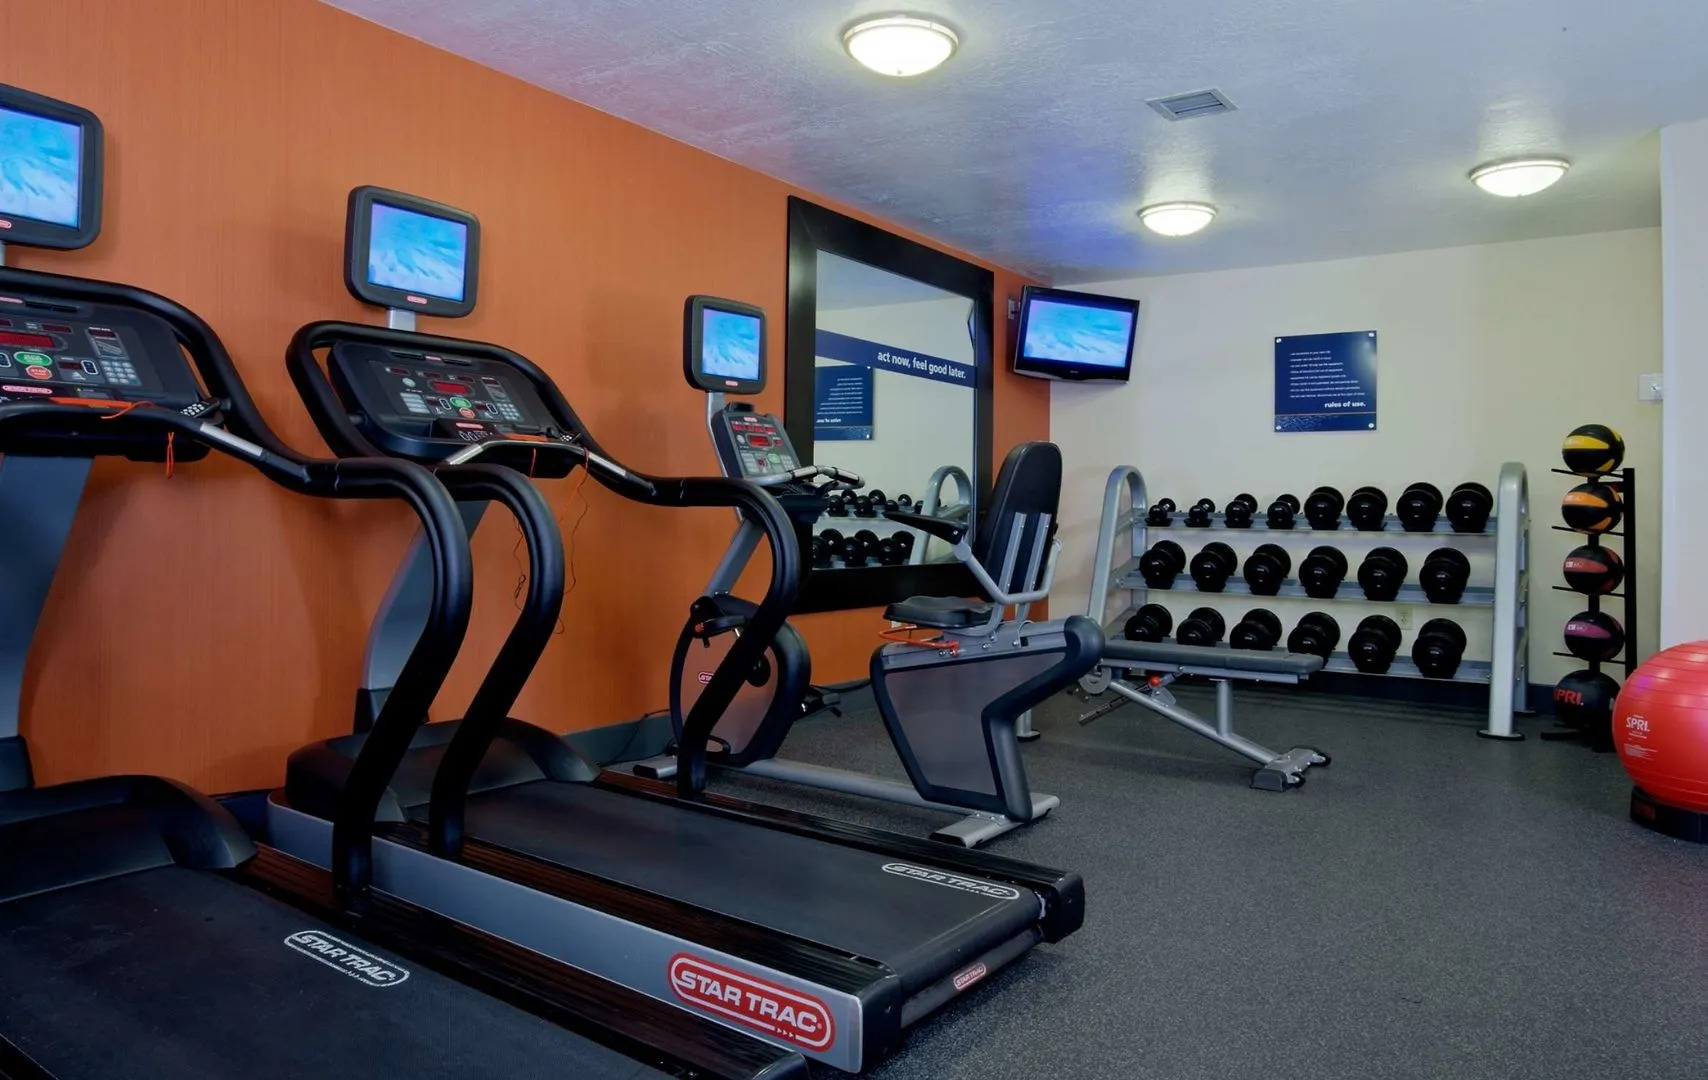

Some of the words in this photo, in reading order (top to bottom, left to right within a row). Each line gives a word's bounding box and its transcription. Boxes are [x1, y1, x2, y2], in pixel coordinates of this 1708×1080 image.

[877, 351, 890, 362] act
[892, 355, 911, 369] now,
[912, 357, 927, 371] feel
[928, 363, 947, 375] good
[948, 365, 966, 379] later.
[891, 865, 946, 881] STAR
[947, 877, 1005, 895] TRAC
[292, 934, 347, 958] STAR
[340, 954, 396, 981] TRAC
[675, 970, 741, 1006] STAR
[746, 992, 818, 1033] TRAC
